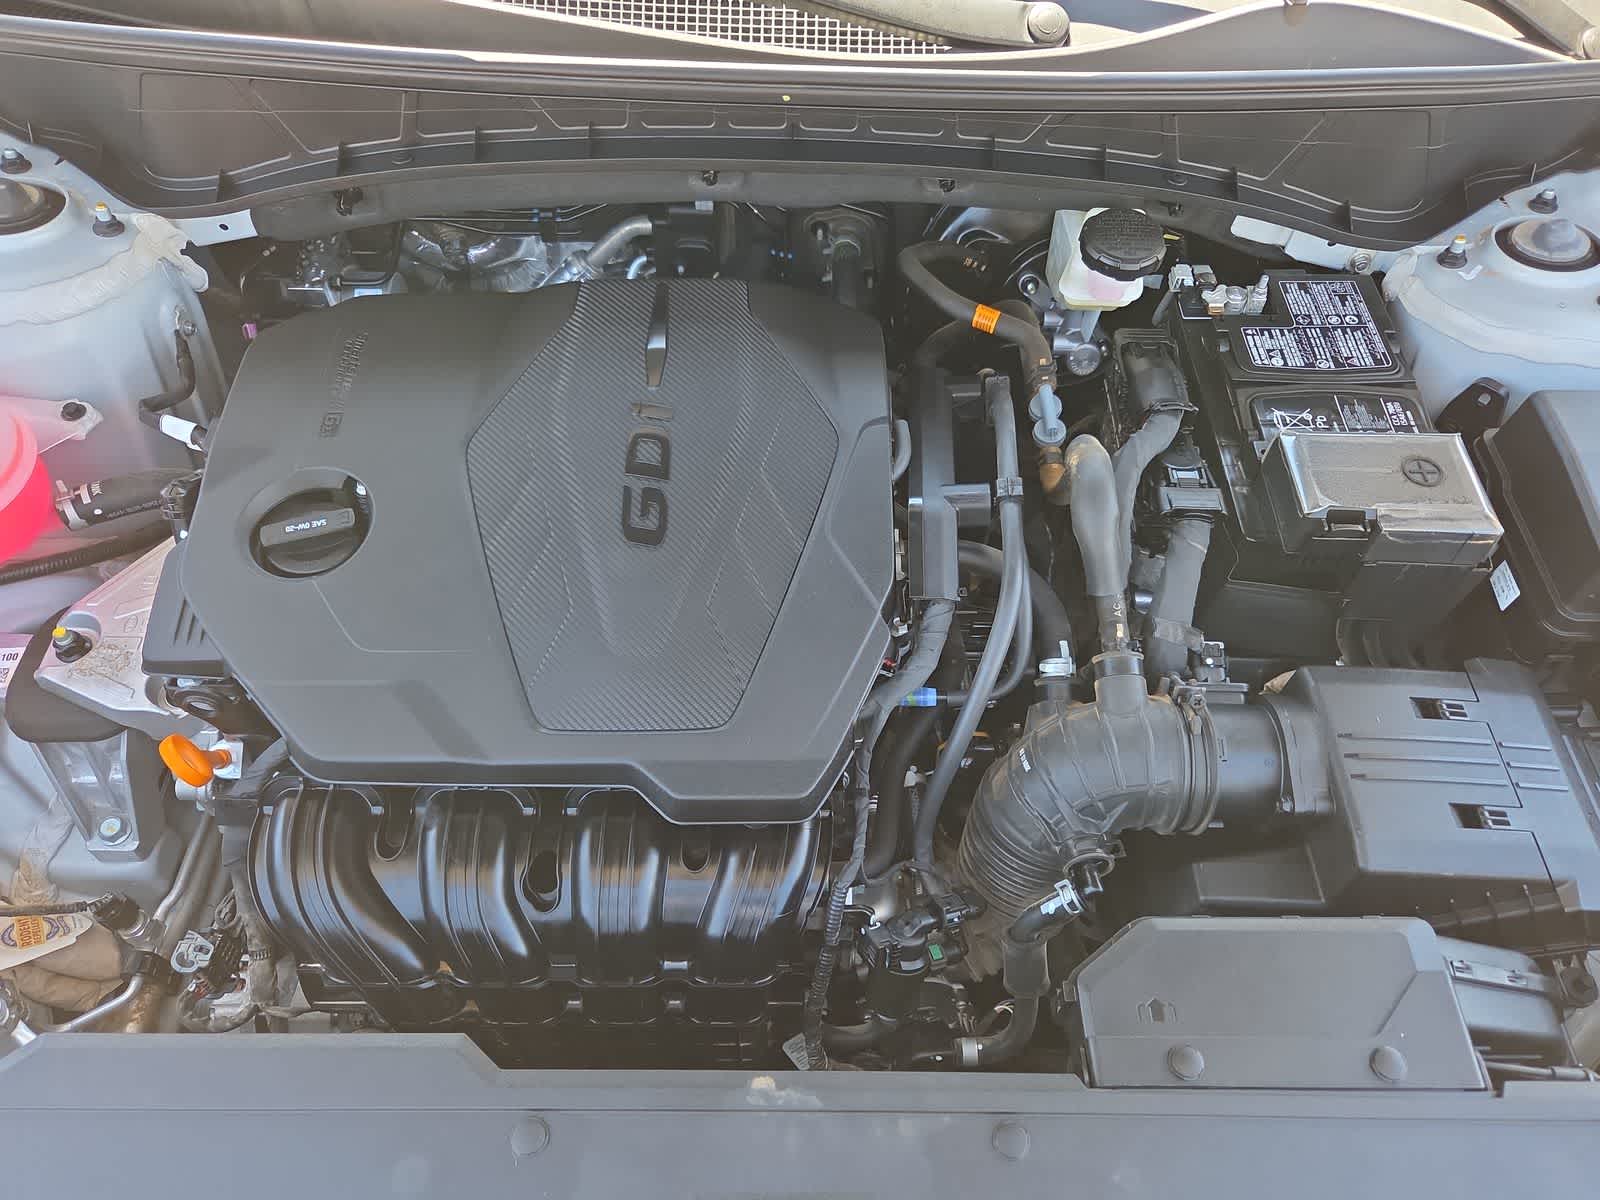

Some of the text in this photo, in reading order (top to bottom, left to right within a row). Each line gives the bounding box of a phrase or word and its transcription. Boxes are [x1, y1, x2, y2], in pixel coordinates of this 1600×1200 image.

[1315, 415, 1330, 430] Pb
[285, 519, 327, 533] SAE 0W-20
[1, 652, 19, 662] 100
